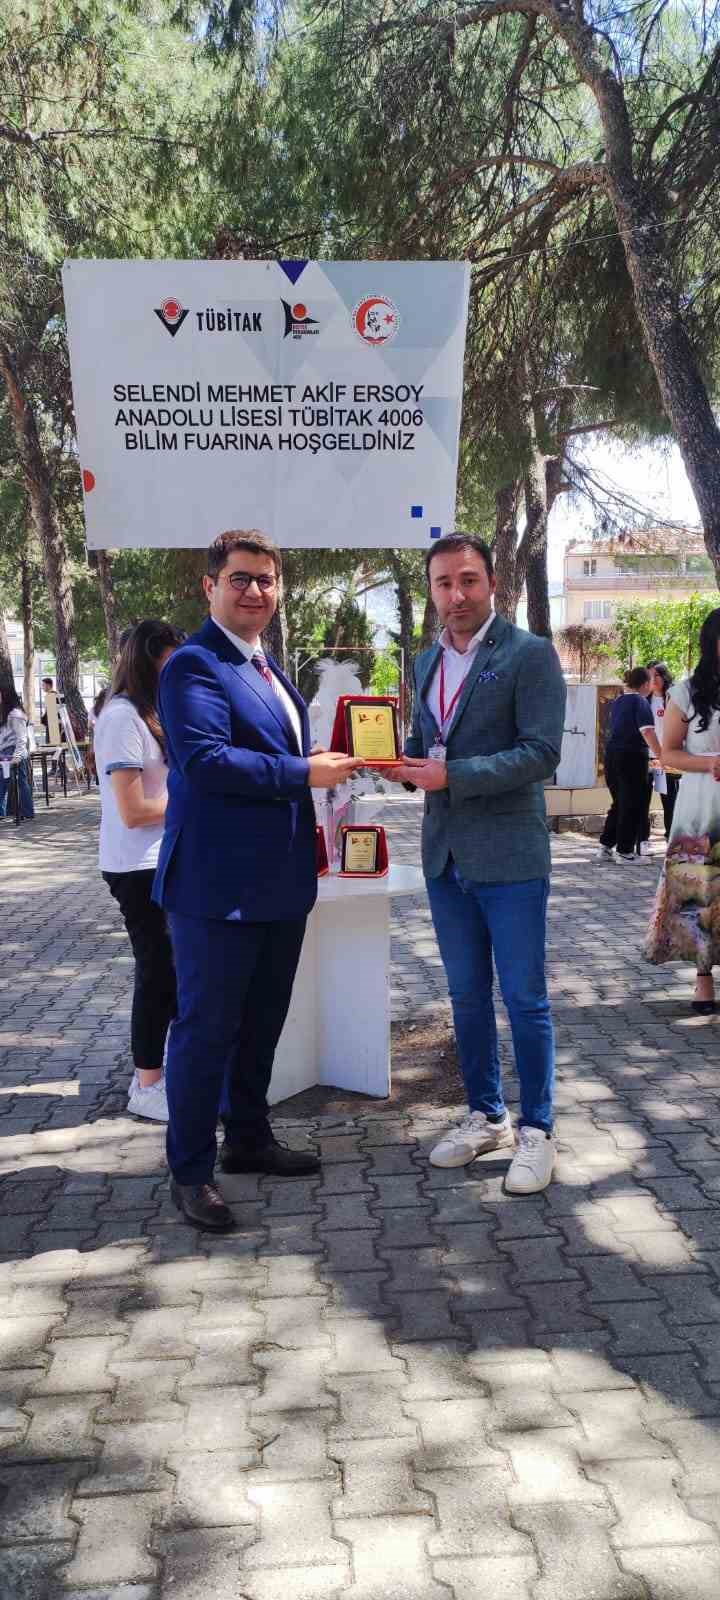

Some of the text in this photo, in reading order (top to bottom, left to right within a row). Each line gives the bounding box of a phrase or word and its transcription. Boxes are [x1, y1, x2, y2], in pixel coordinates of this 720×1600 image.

[196, 308, 262, 332] TÜBİTAK
[113, 381, 424, 402] SELENDİ MEHMET AKİF ERSOY
[115, 406, 424, 427] ANADOLU LİSESİ TÜBİTAK 4006
[125, 430, 415, 454] BİLİM FUARINA HOŞGELDİNİZ
